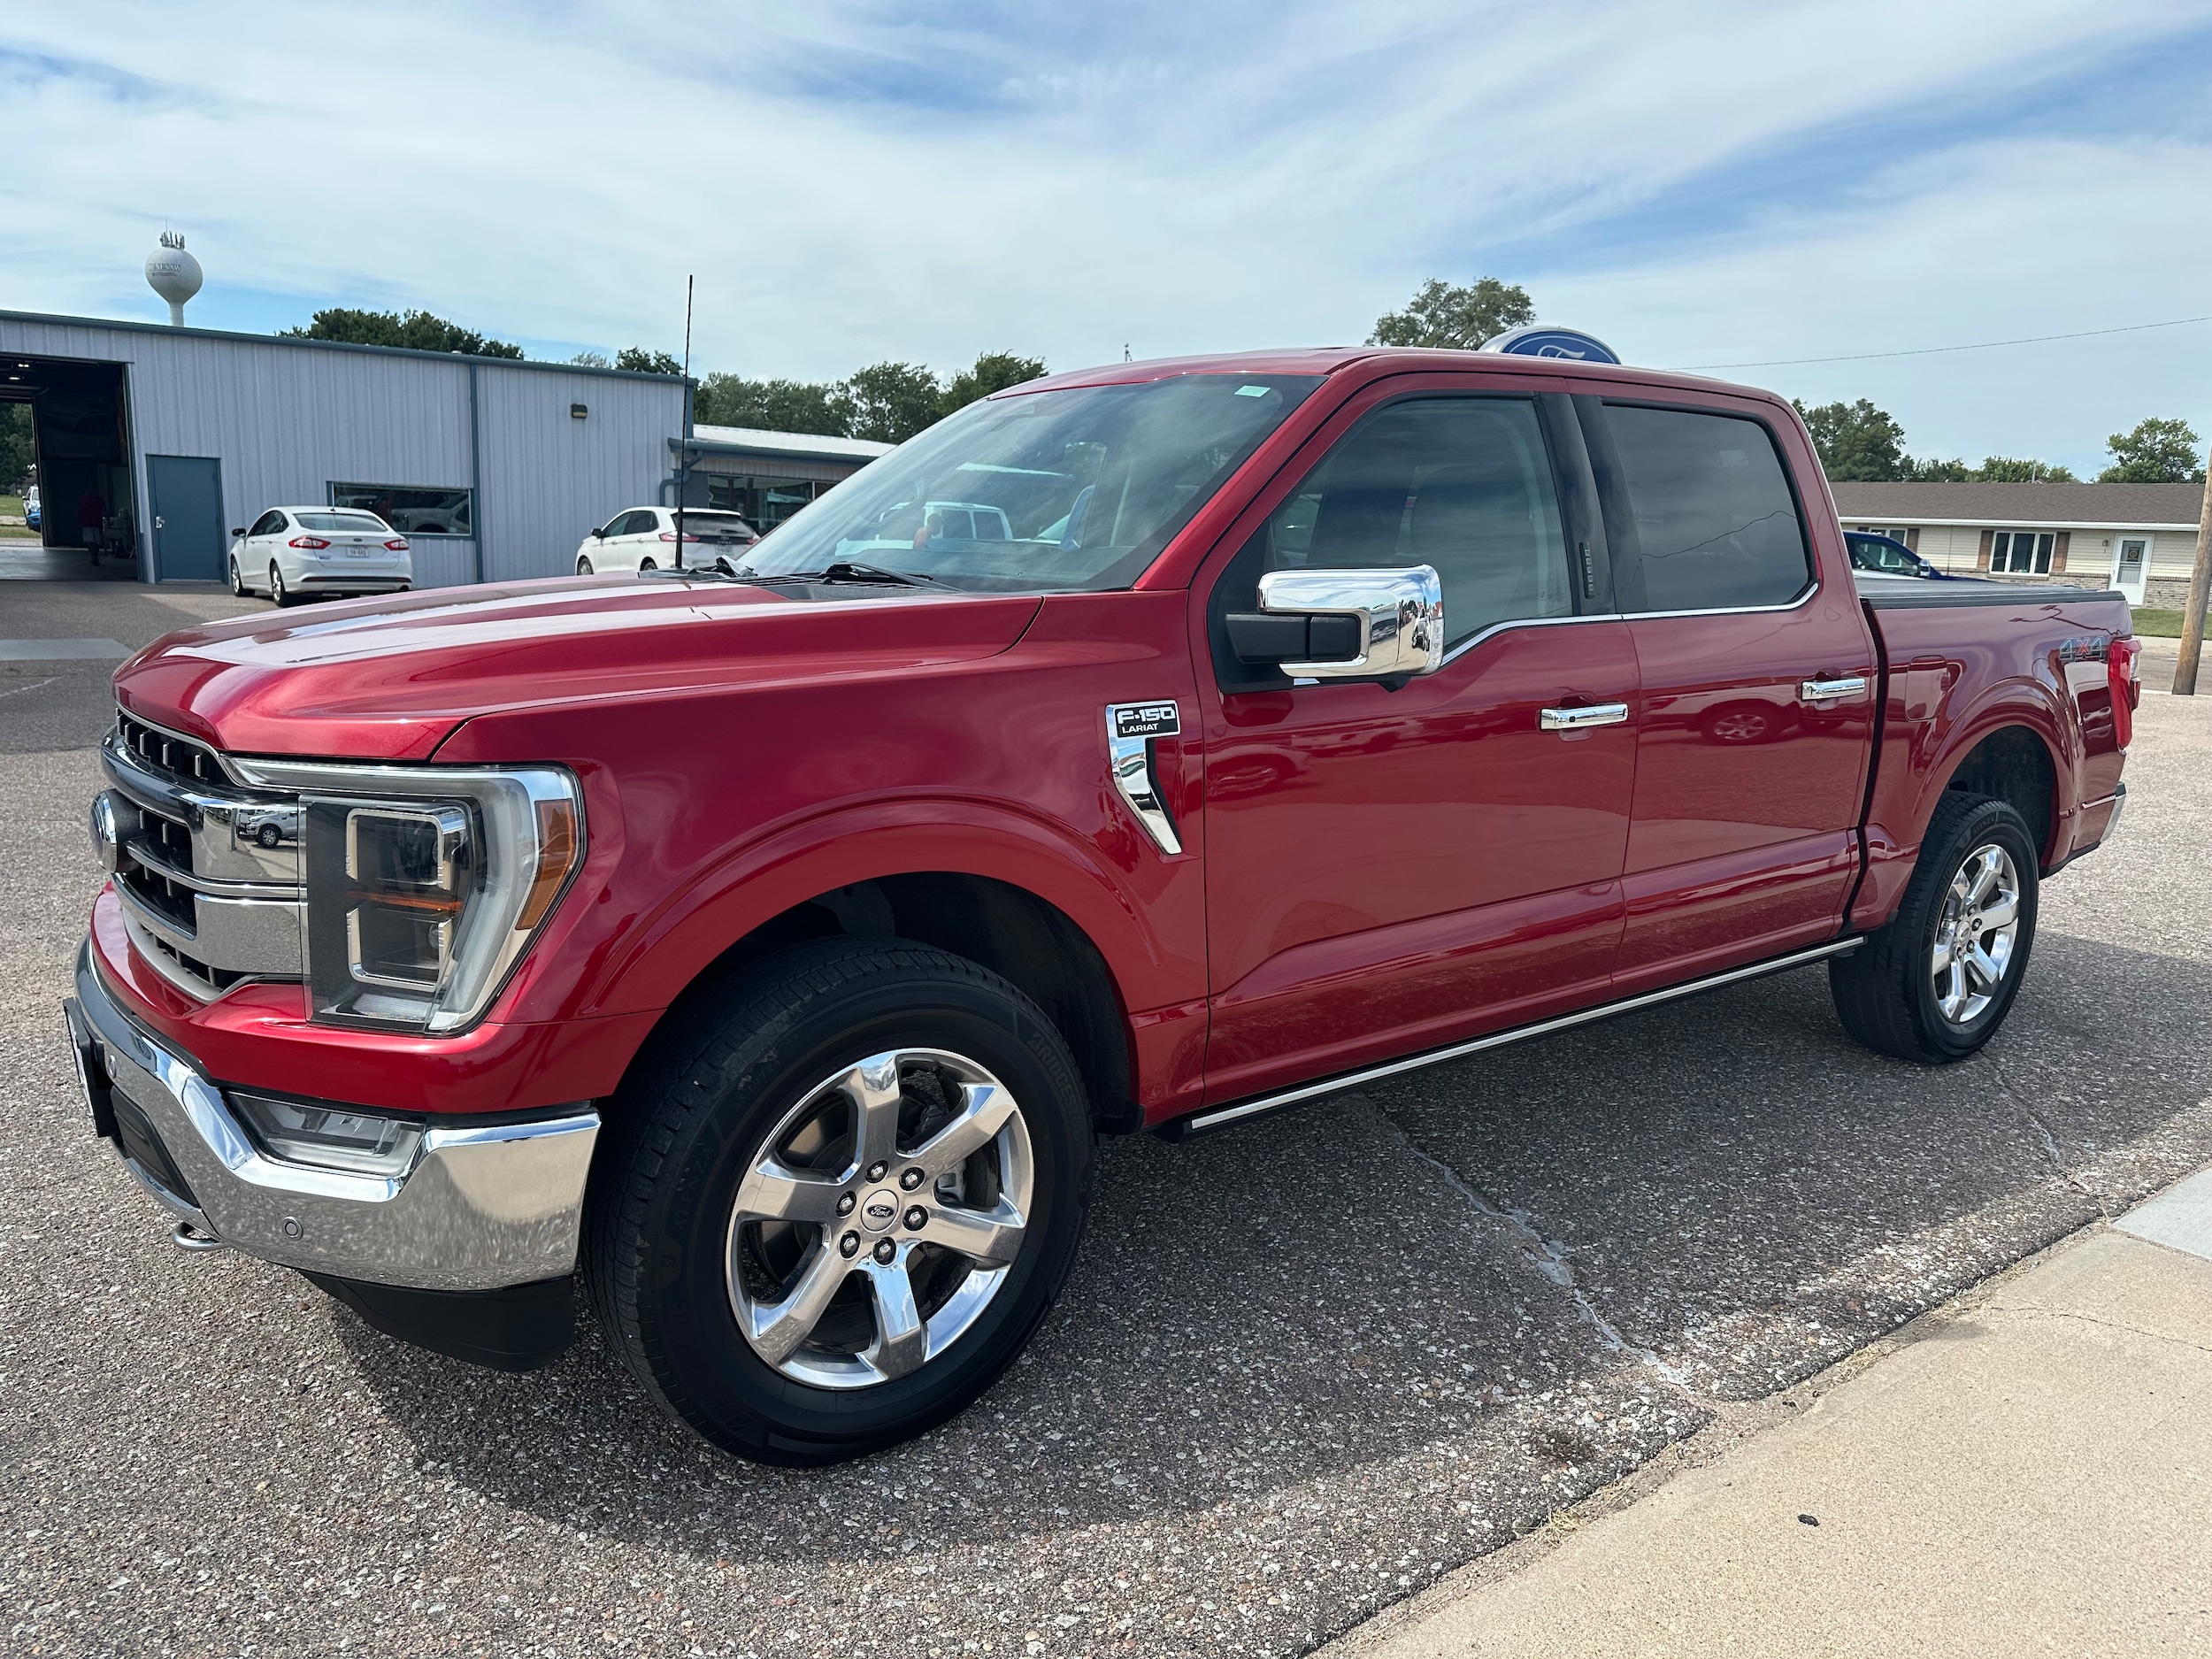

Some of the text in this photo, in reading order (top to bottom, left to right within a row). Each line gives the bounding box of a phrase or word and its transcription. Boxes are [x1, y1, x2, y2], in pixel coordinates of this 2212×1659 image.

[1117, 706, 1176, 724] F-150
[1121, 723, 1158, 733] LARIAT
[674, 1147, 714, 1232] ALENZA
[871, 1205, 891, 1217] Ford
